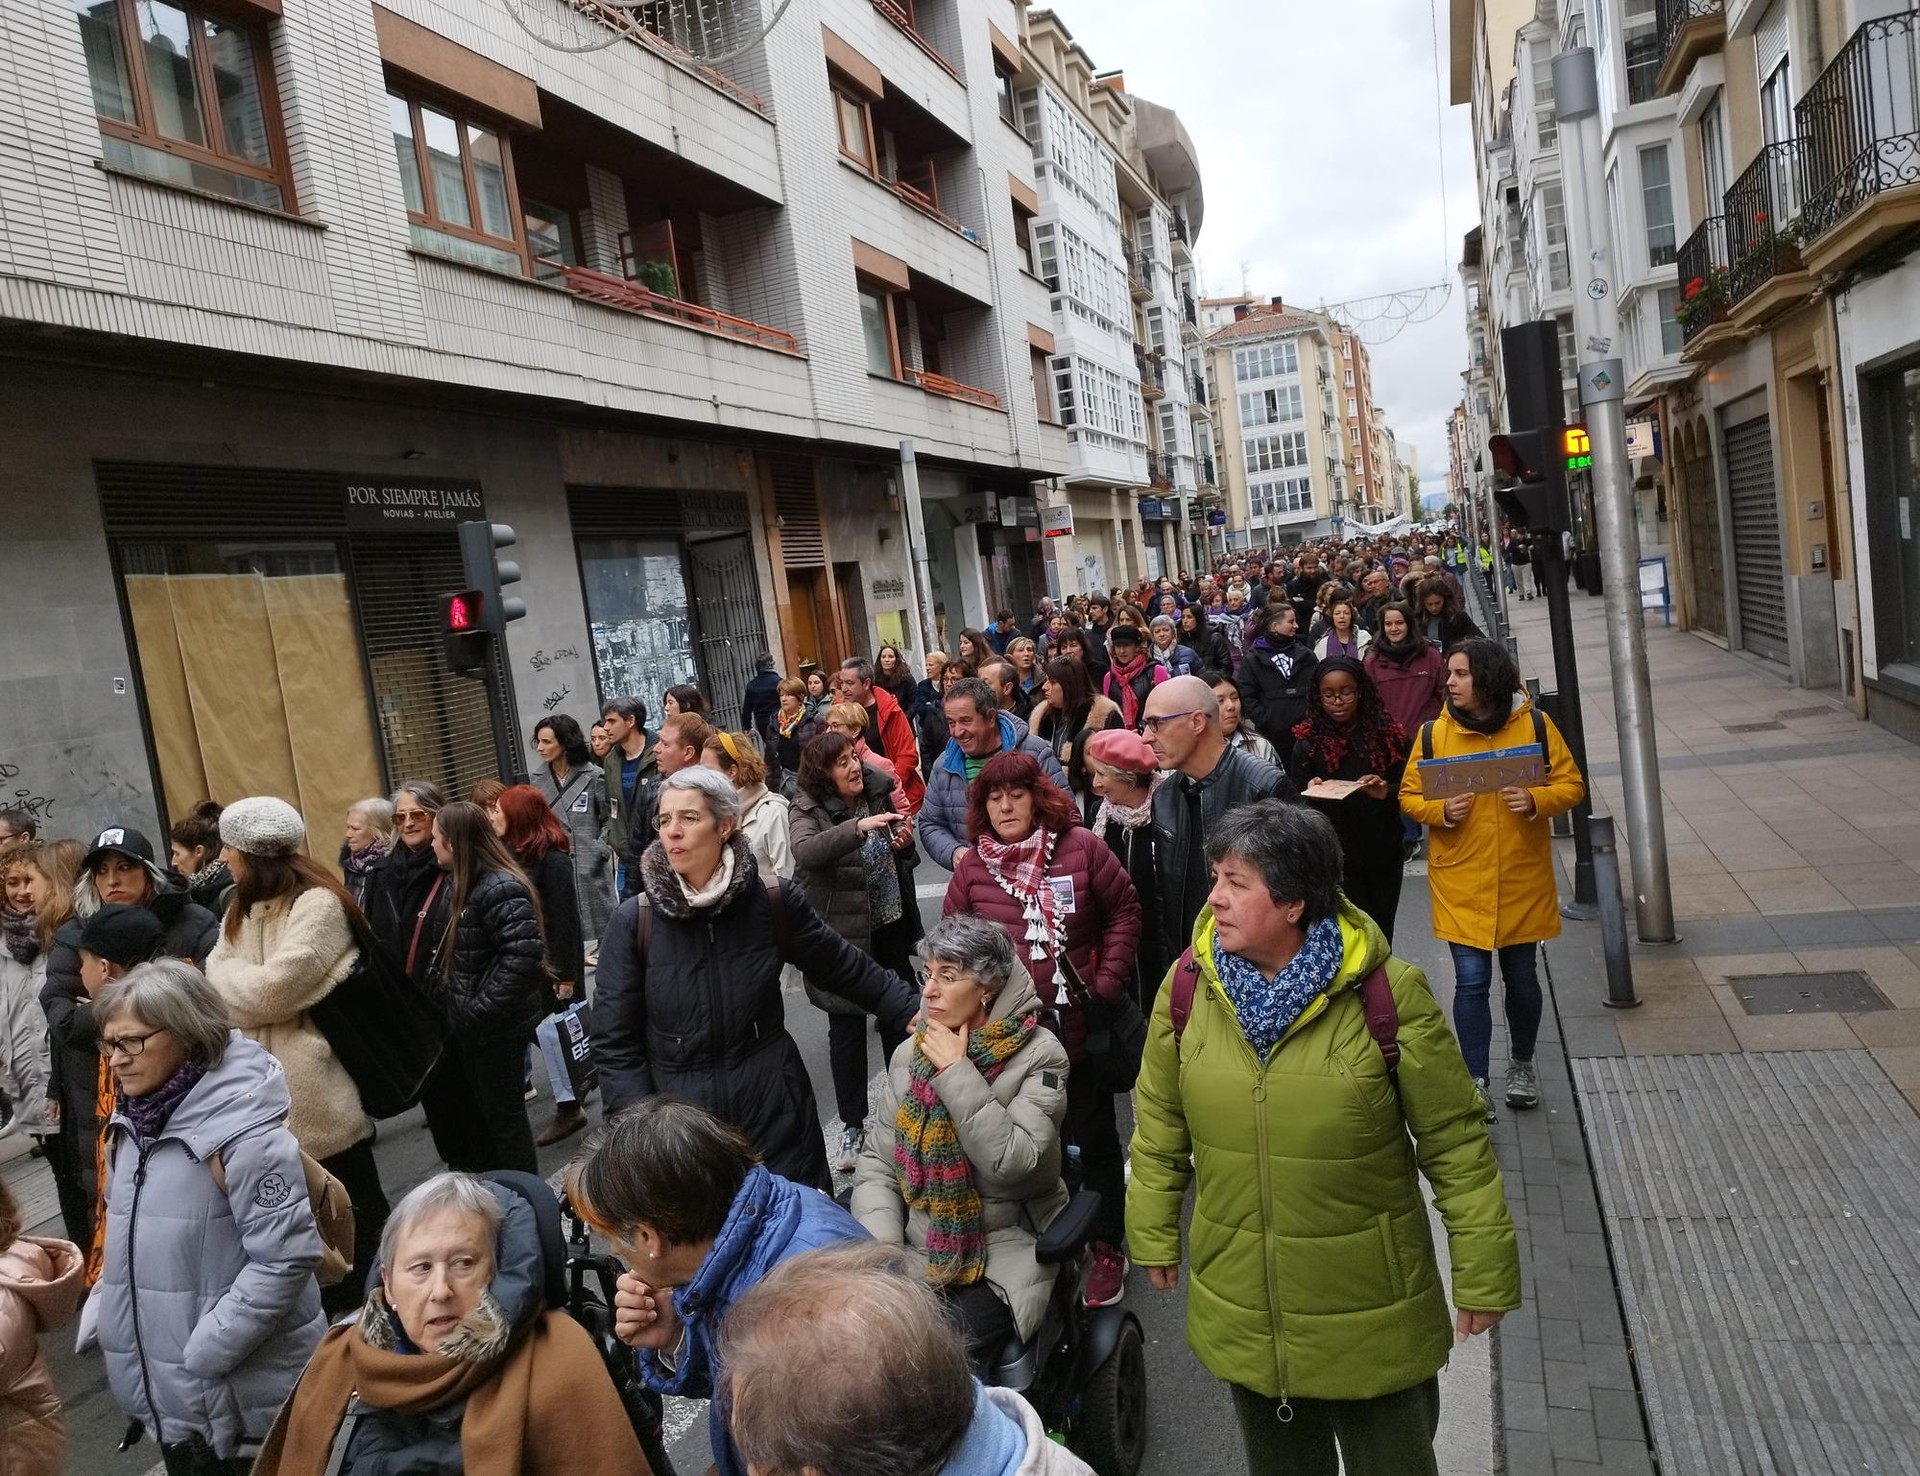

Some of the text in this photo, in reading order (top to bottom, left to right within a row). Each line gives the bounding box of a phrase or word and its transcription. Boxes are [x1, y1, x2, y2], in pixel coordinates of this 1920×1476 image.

[347, 487, 482, 509] POR SIEMPRE JAMÁS
[383, 509, 414, 518] NOVIAS
[423, 510, 456, 519] ATELIER
